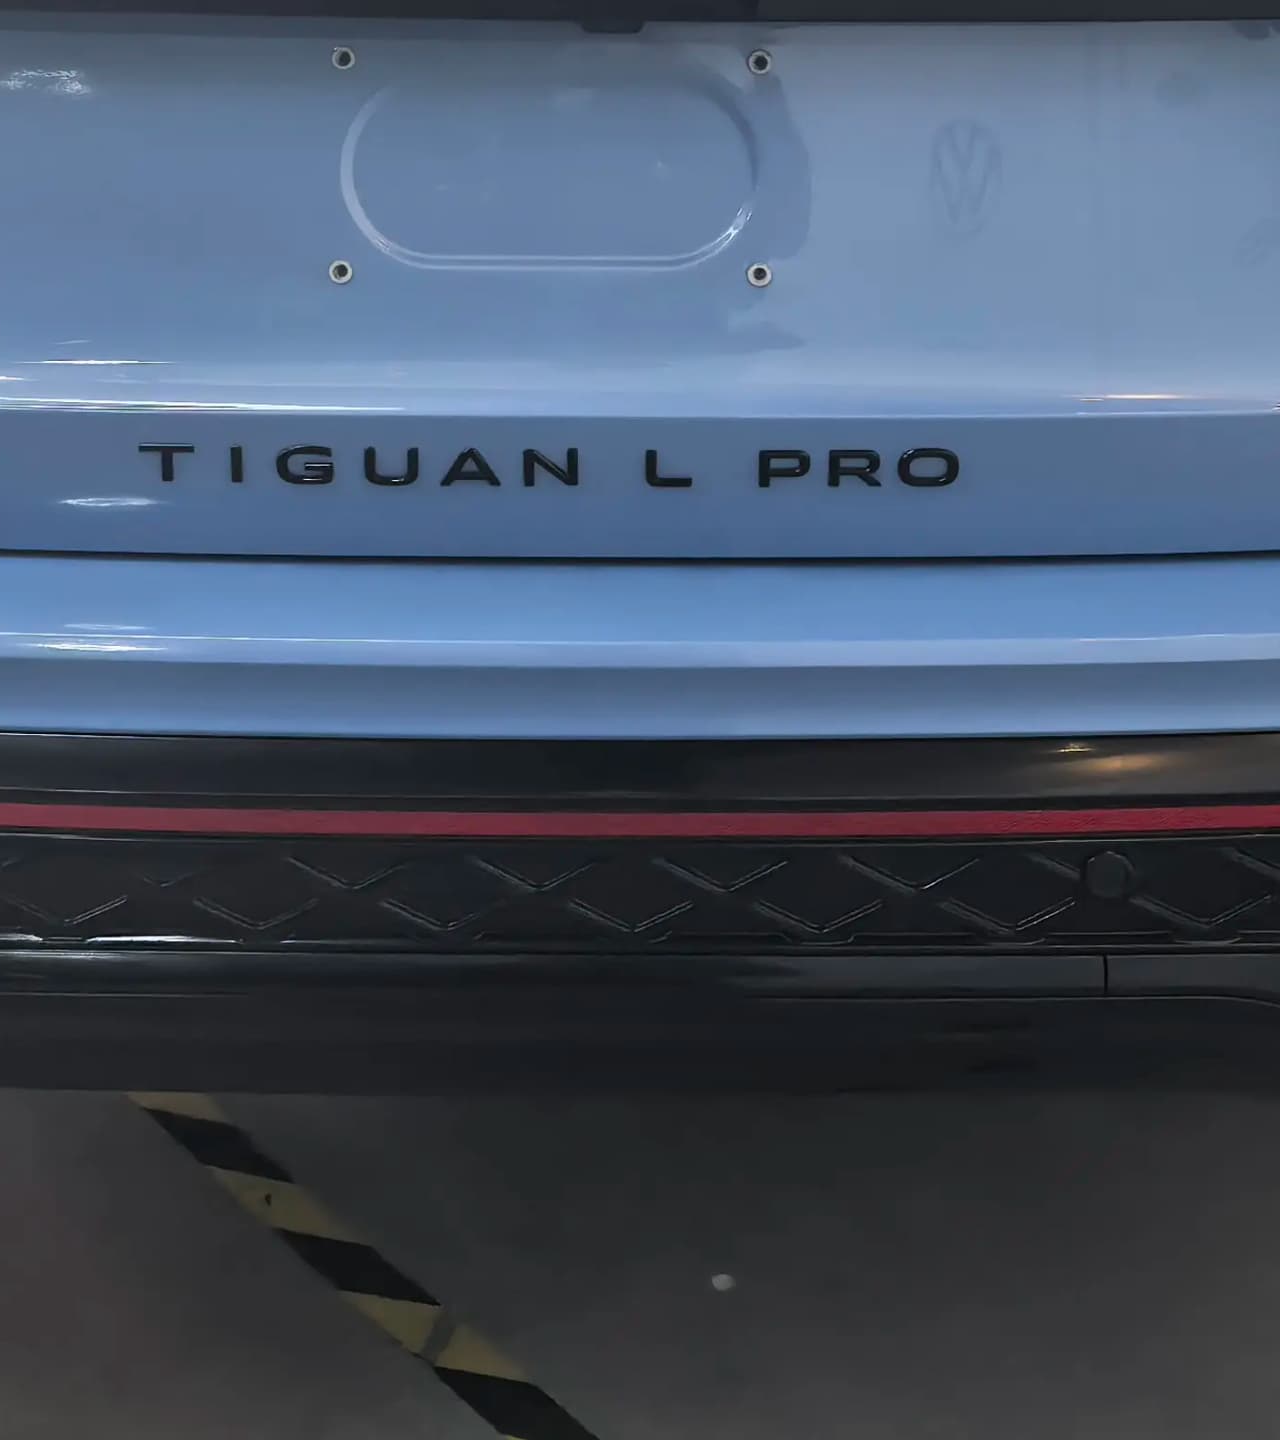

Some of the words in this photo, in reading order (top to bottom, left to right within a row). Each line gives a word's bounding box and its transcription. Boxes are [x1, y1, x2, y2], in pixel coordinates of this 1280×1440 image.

[138, 442, 580, 487] TIGUAN
[644, 448, 693, 487] L
[758, 446, 961, 489] PRO
